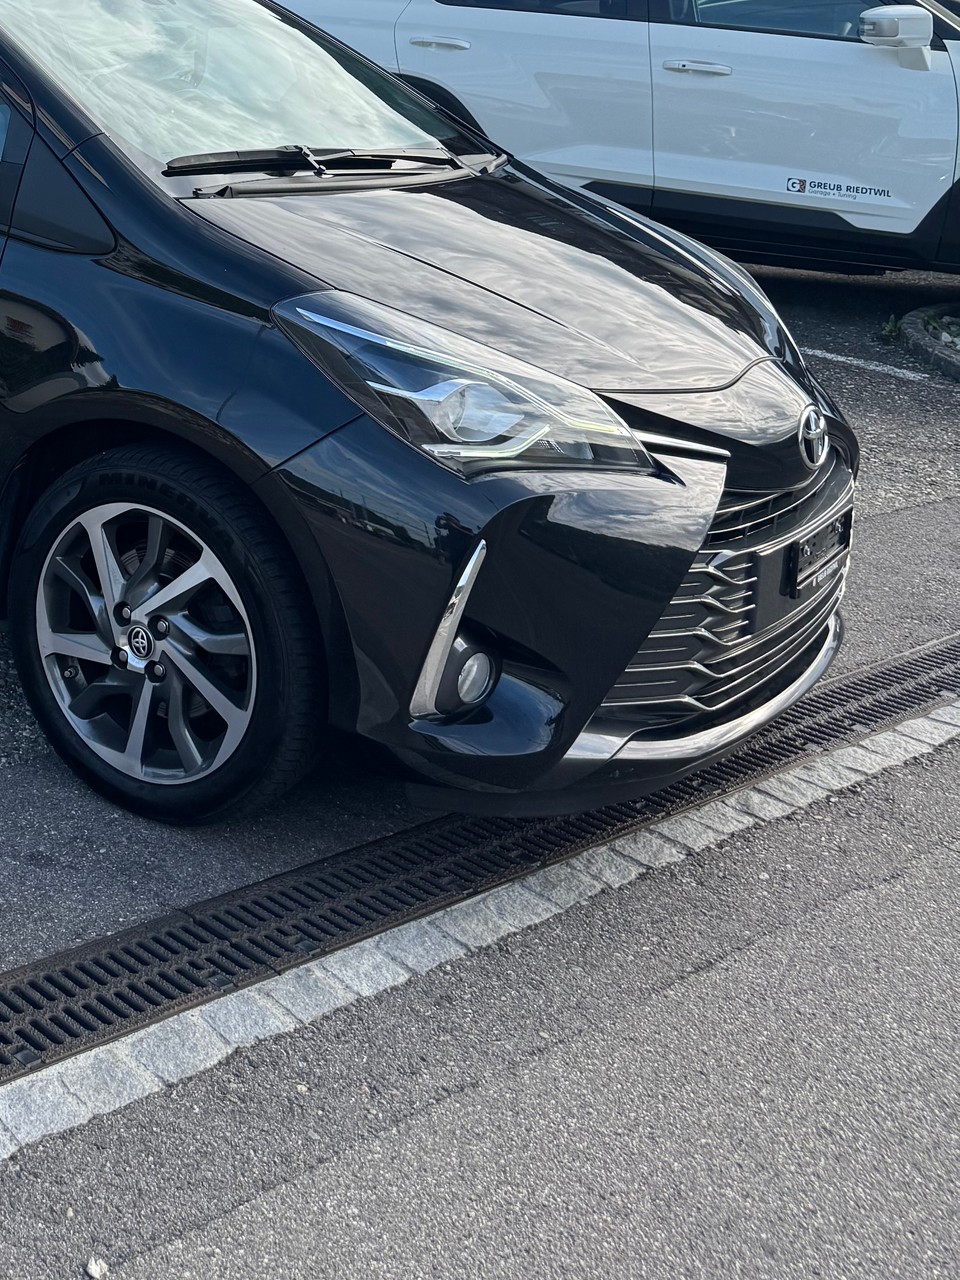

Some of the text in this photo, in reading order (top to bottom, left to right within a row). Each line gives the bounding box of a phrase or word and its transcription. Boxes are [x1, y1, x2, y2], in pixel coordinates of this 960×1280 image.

[808, 189, 857, 200] Garage Tuning
[809, 181, 842, 192] GREUB
[846, 185, 891, 198] RIEDTWIL
